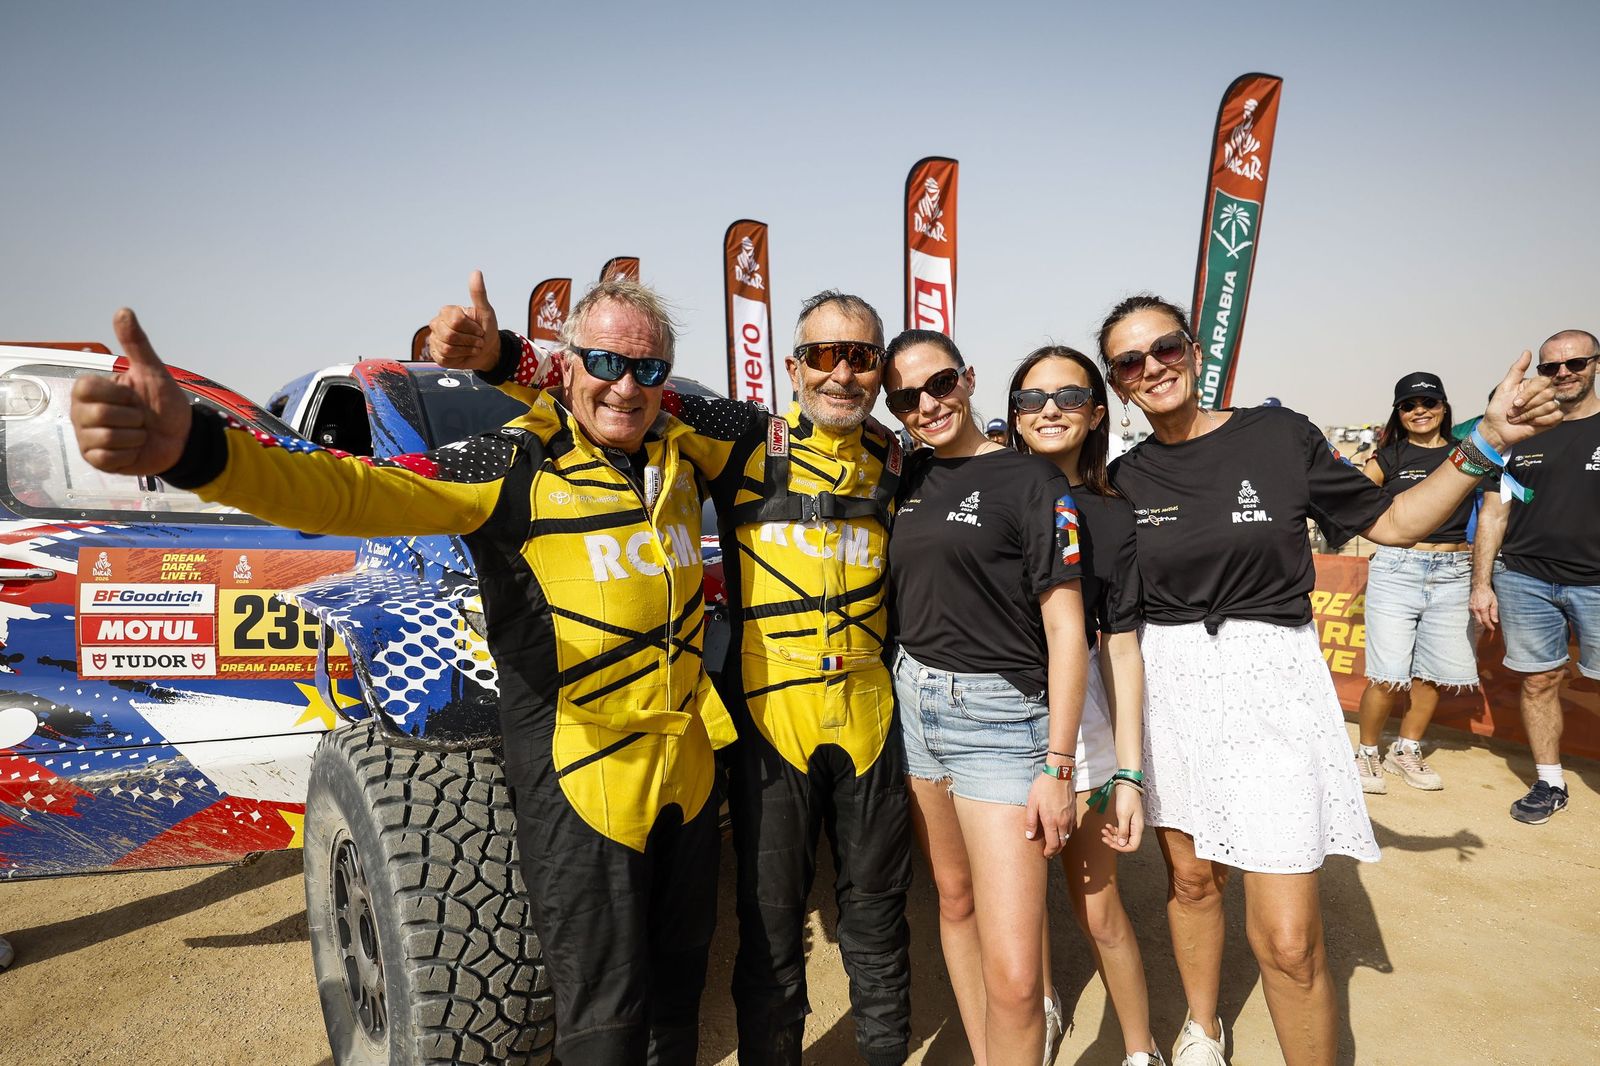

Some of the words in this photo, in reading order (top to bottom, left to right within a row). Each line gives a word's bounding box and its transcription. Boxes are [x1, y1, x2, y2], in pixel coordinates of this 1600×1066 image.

[1224, 142, 1263, 182] DAKAR
[914, 212, 947, 242] DAKAR
[735, 265, 765, 290] DAKAR
[918, 288, 945, 334] UL
[1209, 270, 1237, 360] ARABIA
[1585, 463, 1600, 471] RC
[1237, 495, 1260, 505] DAKAR
[945, 511, 982, 527] RCM.
[1231, 510, 1273, 524] RCM.
[162, 553, 207, 563] DREAM.
[92, 567, 112, 577] DAKAR
[161, 563, 196, 571] DARE.
[160, 572, 188, 580] LIVE
[188, 572, 202, 580] IT.
[233, 570, 253, 580] DAKAR
[93, 590, 203, 602] BFGoodrich
[1308, 591, 1366, 618] REA
[97, 620, 198, 641] MOTUL
[1314, 619, 1367, 648] RE
[112, 655, 188, 668] TUDOR
[220, 663, 266, 672] DREAM.
[269, 663, 304, 672] DARE.
[307, 663, 334, 672] LIE
[335, 663, 349, 672] IT.
